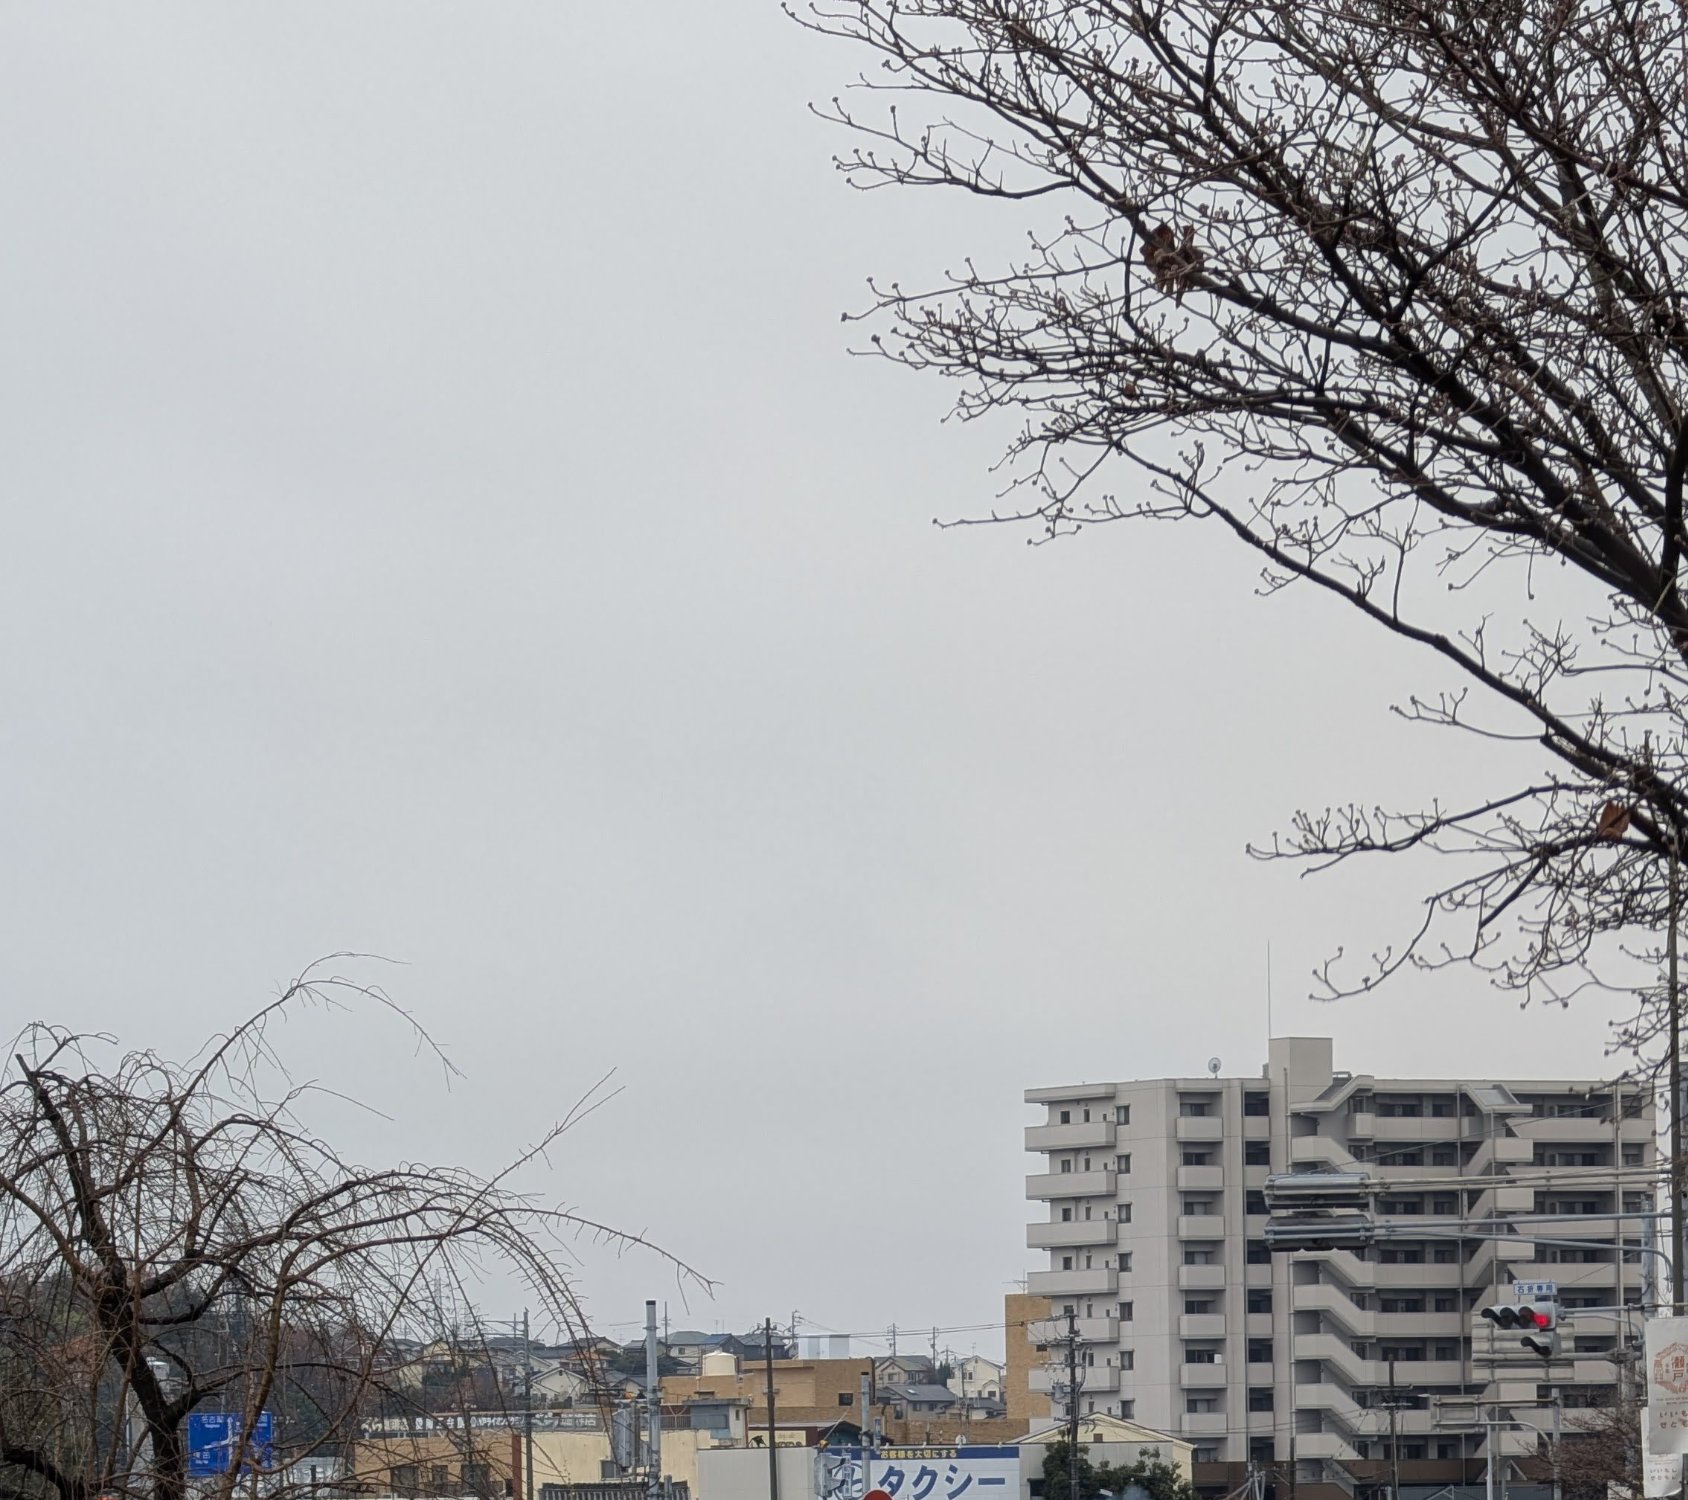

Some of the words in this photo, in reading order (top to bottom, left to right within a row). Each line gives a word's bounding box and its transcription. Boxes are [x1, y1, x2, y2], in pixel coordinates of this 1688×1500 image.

[880, 1450, 957, 1459] お客様を大切にする
